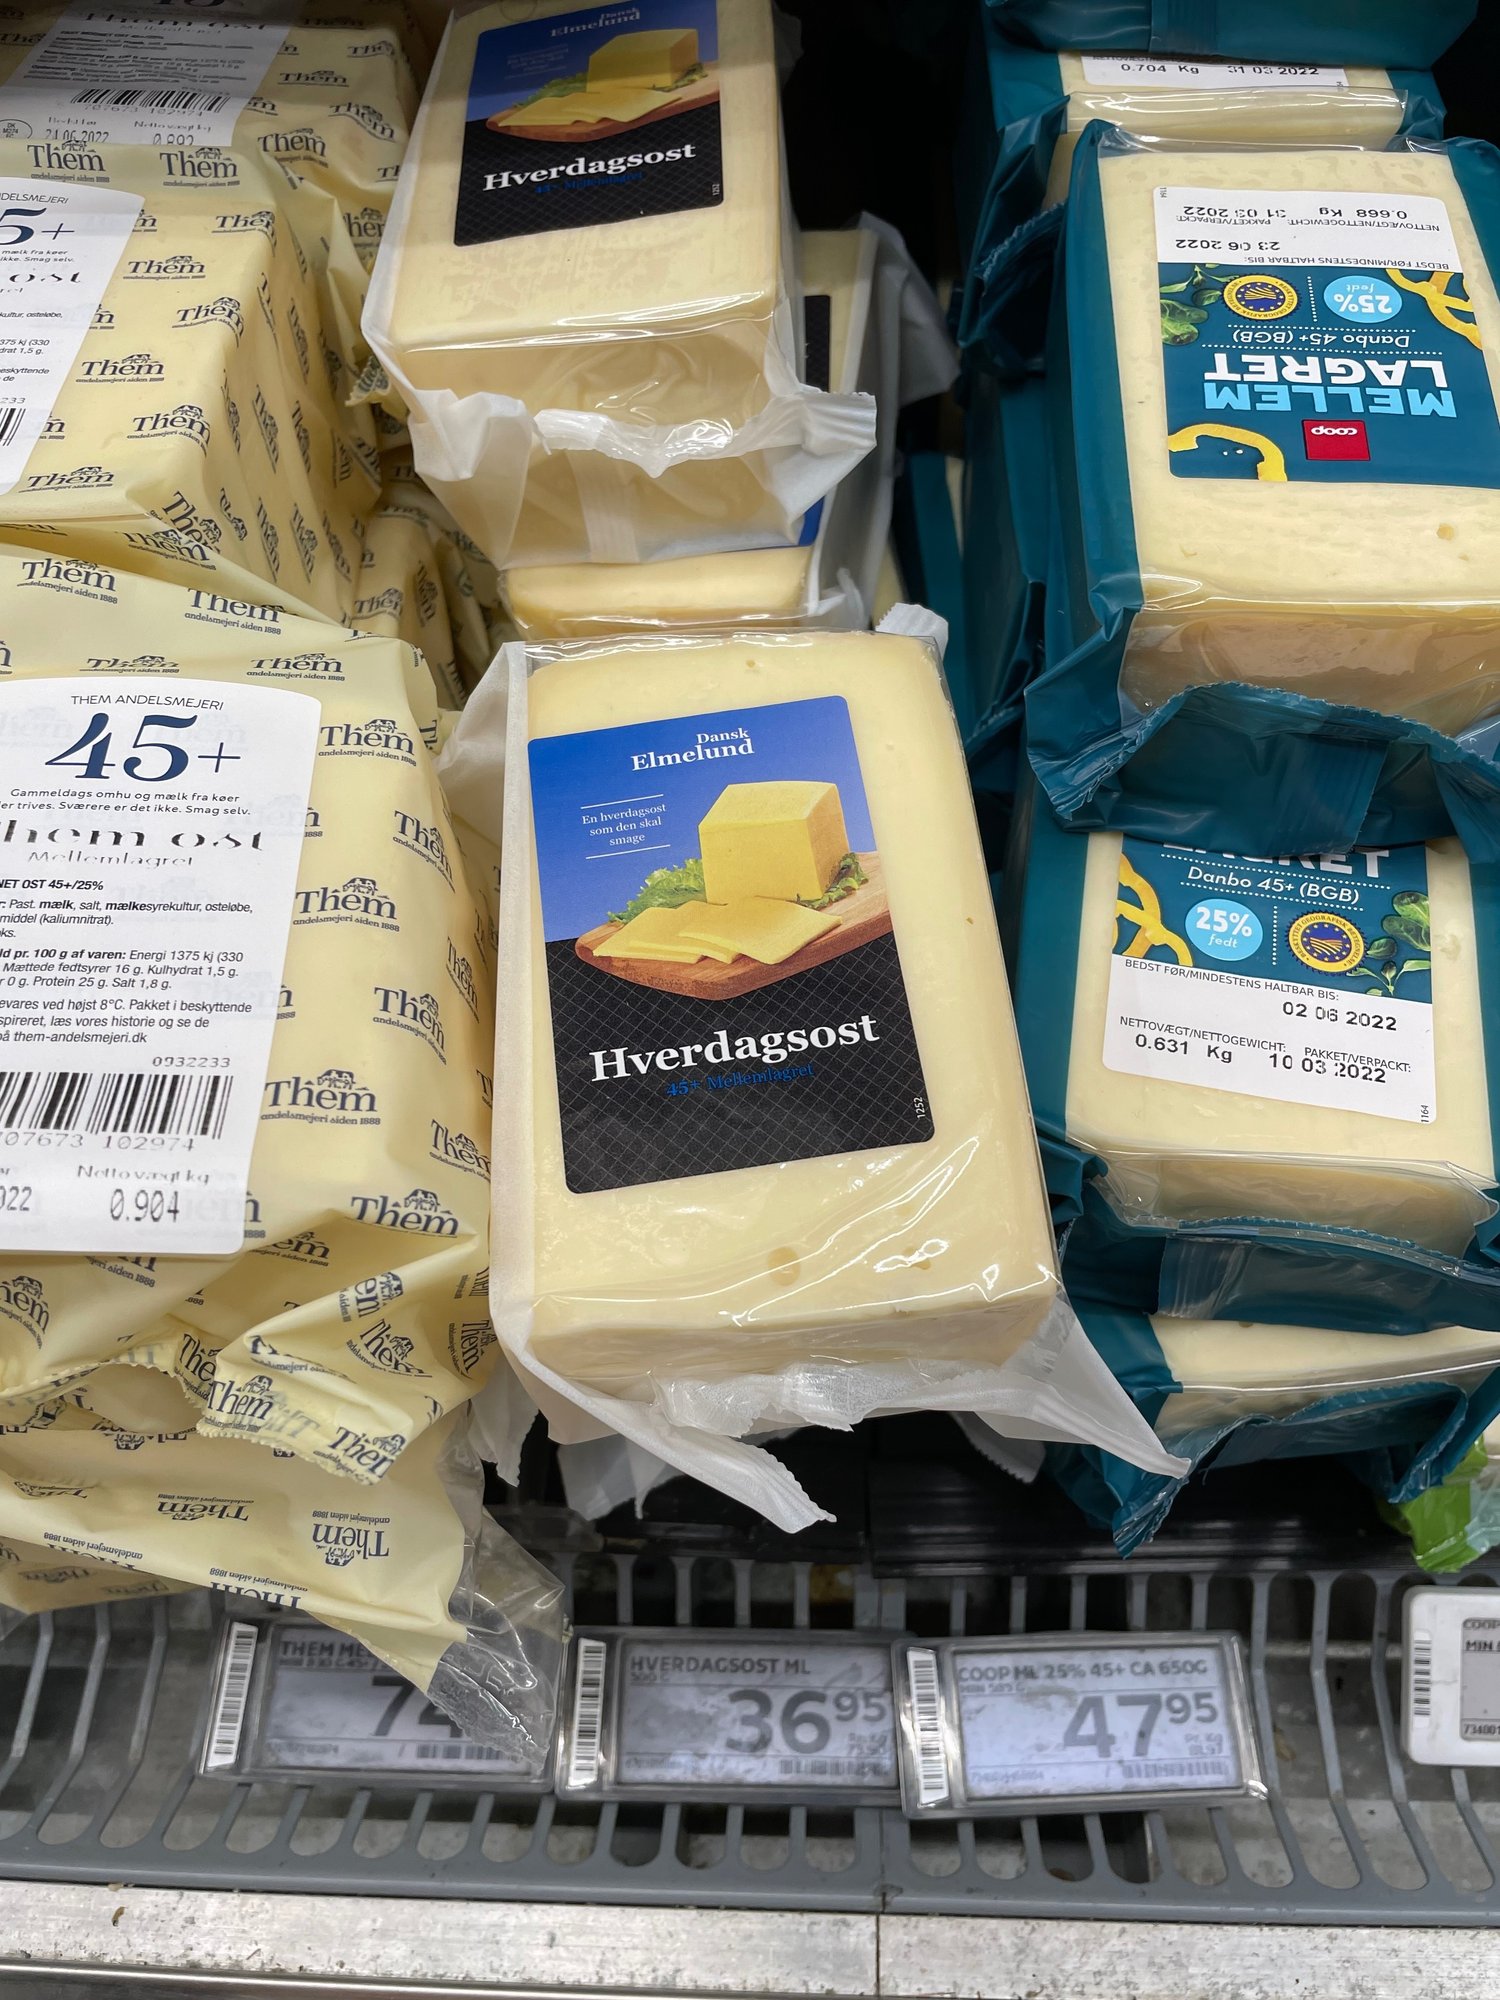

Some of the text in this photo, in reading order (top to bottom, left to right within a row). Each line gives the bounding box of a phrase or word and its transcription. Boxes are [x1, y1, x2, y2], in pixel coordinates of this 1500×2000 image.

[280, 72, 347, 85] Them
[1178, 65, 1199, 76] Kg
[1278, 66, 1320, 76] 2022
[329, 103, 395, 139] Them
[258, 131, 327, 157] Them
[27, 143, 106, 171] Them
[160, 151, 238, 177] Them
[482, 143, 696, 192] Hverdagsost
[1183, 206, 1229, 218] 2022
[1319, 207, 1342, 219] Kg
[1357, 208, 1408, 219] 0.668
[1176, 239, 1223, 250] 2022
[128, 260, 206, 275] Them
[1243, 255, 1449, 270] BEDST FØR/MINDESTENS HALTBAR BIS:
[1346, 284, 1376, 292] fedt
[1334, 294, 1393, 314] 25%
[1232, 331, 1410, 348] Danbo 45+ (BGB)
[81, 360, 164, 376] Them
[1204, 353, 1448, 388] LAGRET
[1204, 382, 1457, 418] MELLEM
[1311, 426, 1358, 436] coop
[28, 472, 114, 489] Them
[22, 558, 116, 591] Them
[185, 611, 239, 627] andelsmejeri
[251, 658, 342, 673] Them
[71, 695, 224, 710] THEM ANDELSMEJERI
[320, 724, 415, 755] Them
[697, 728, 749, 745] Dansk
[45, 712, 241, 782] 45+
[631, 738, 755, 771] Elmelund
[10, 788, 240, 802] Gammeldags omhu og mælk fra køer
[17, 801, 55, 810] trives.
[59, 801, 111, 811] Sværere
[131, 803, 150, 812] det
[154, 803, 182, 813] ikke.
[186, 805, 218, 816] Smag
[223, 805, 251, 815] selv.
[582, 803, 667, 824] En hverdagsost
[590, 816, 662, 836] som den skal
[394, 810, 453, 880] Them
[609, 833, 646, 846] smage
[22, 879, 104, 891] OST 45+/25%
[1188, 866, 1360, 905] Danbo 45+ (BGB)
[9, 899, 35, 908] Past.
[39, 900, 76, 911] mælk,
[79, 901, 103, 911] salt,
[106, 901, 202, 913] mælkesyrekultur,
[205, 901, 254, 913] osteløbe,
[296, 887, 397, 920] Them
[40, 914, 114, 925] (kaliumnitrat).
[293, 915, 353, 925] andelsmejeri
[1195, 906, 1253, 938] 25%
[1208, 934, 1238, 949] fedt
[14, 950, 29, 960] pr.
[34, 949, 57, 958] 100
[59, 951, 67, 960] g
[71, 949, 85, 959] af
[88, 950, 127, 960] varen:
[130, 950, 166, 962] Energi
[171, 951, 200, 961] 1375
[203, 951, 213, 963] kj
[217, 952, 243, 963] (330
[3, 962, 226, 977] Mættede fedtsyrer 16 Kulhydrat 1,5
[33, 976, 158, 989] Protein 25 Salt 1,8
[1125, 958, 1339, 1001] BEDST FØR/MINDESTENS HALTBAR BIS:
[43, 1000, 252, 1013] ved højst Pakket beskyttende
[51, 1015, 209, 1029] læs vores historie og se de
[374, 986, 445, 1050] Them
[1282, 1001, 1398, 1031] 02 2022
[14, 1031, 147, 1044] them-andelsmejeri.dk
[1120, 1015, 1287, 1053] NETTOVÆGT/NETTOGEWICHT:
[589, 1014, 880, 1082] Hverdagsost
[1135, 1033, 1387, 1084] 0.631 Kg 10 2022
[1304, 1046, 1412, 1073] PAKKET/VERPACKT:
[264, 1076, 378, 1112] Them
[665, 1077, 701, 1097] 45+
[915, 1096, 924, 1119] 1252
[261, 1112, 329, 1124] andelsmejeri
[103, 1135, 195, 1151] 102974
[110, 1188, 180, 1222] 0.904
[351, 1195, 459, 1238] Them
[135, 1274, 155, 1287] 1888
[208, 1380, 274, 1420] Them
[158, 1501, 249, 1521] Them
[312, 1523, 389, 1559] Them
[86, 1542, 143, 1560] andelsmejeri
[253, 1576, 308, 1592] andelsmejeri
[281, 1641, 334, 1656] THEM
[1466, 1641, 1492, 1651] MIN
[631, 1656, 811, 1674] HVERDAGSOST ML
[959, 1666, 1010, 1681] COOP
[1045, 1663, 1086, 1679] 25%
[1091, 1662, 1125, 1677] 45+
[1130, 1660, 1154, 1676] CA
